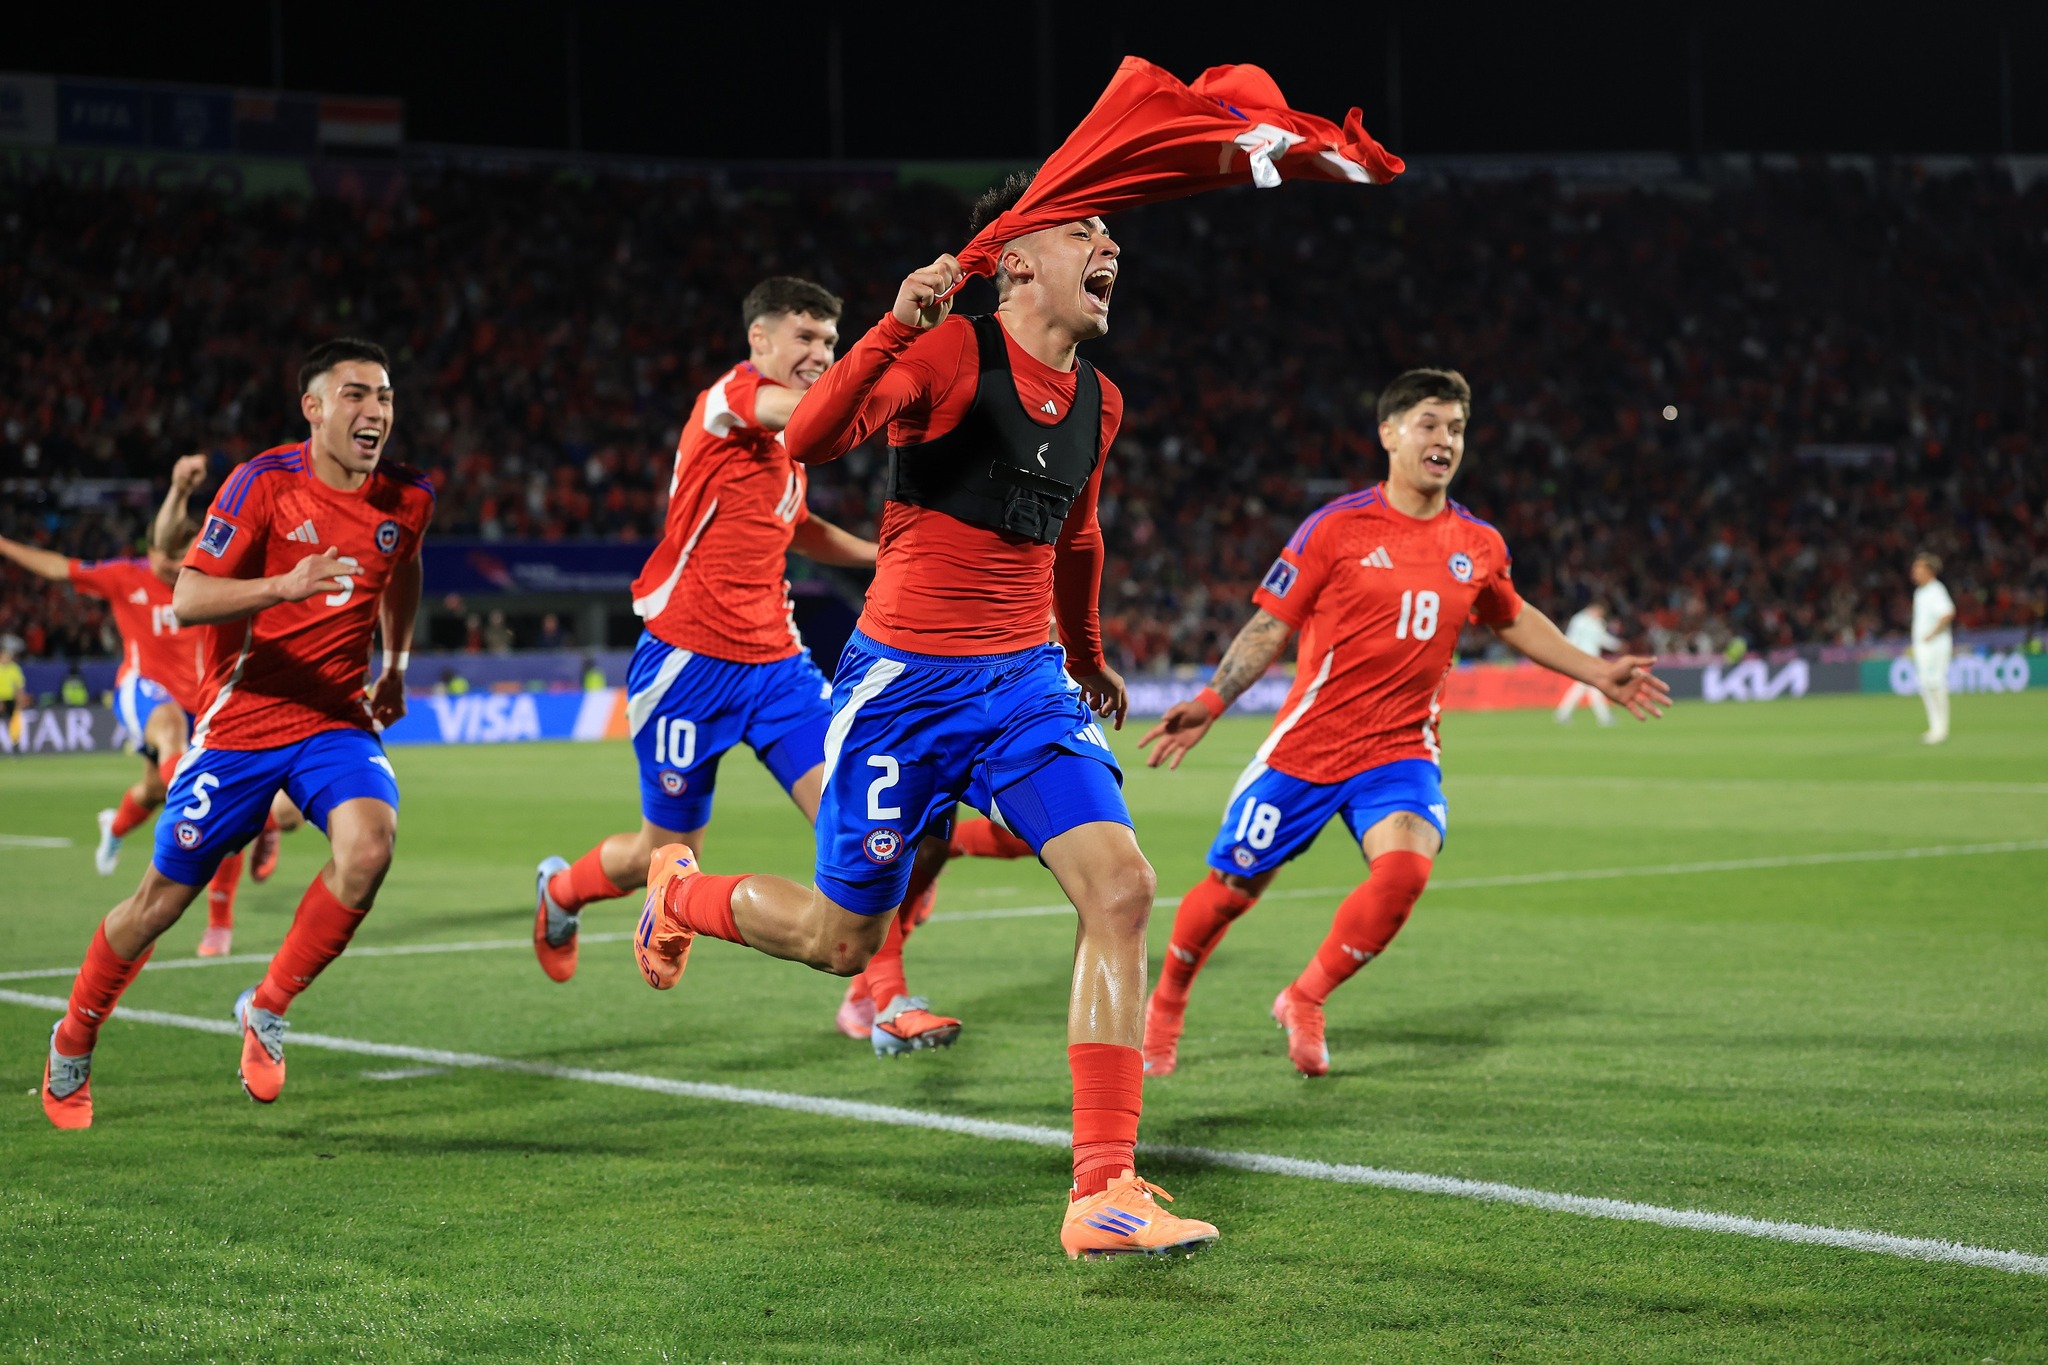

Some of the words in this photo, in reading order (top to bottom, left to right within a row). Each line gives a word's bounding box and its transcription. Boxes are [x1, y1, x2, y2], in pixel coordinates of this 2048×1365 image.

[774, 471, 804, 523] 10
[1395, 589, 1441, 641] 18
[1702, 657, 1811, 703] KIA
[429, 692, 542, 743] VISA
[655, 715, 697, 769] 10
[182, 771, 220, 821] 5
[866, 754, 901, 820] 2
[1233, 796, 1282, 850] 18
